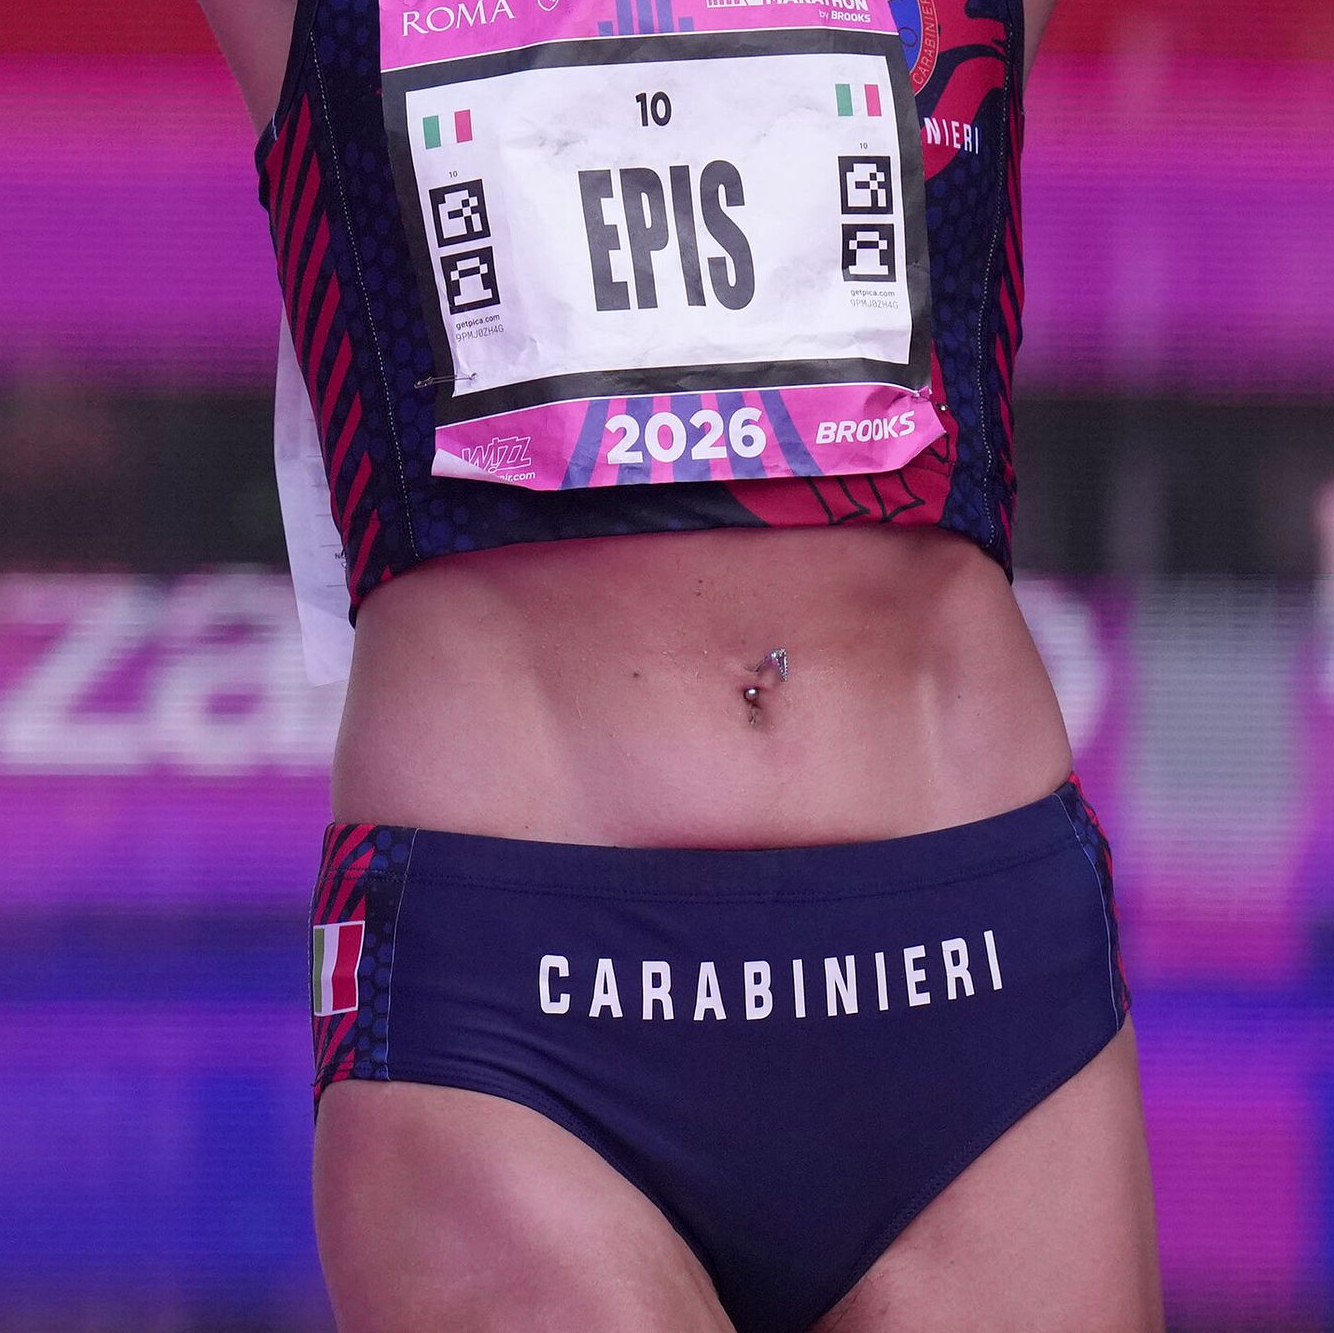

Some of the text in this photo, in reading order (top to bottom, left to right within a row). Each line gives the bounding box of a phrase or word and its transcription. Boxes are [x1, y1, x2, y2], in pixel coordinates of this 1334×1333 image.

[818, 9, 871, 23] by BROOKS
[635, 91, 672, 127] 10
[859, 142, 868, 150] 10
[449, 170, 458, 179] 10
[577, 159, 756, 312] EPIS
[850, 288, 896, 299] getpica.com
[455, 313, 501, 331] getpica.com
[604, 407, 767, 464] 2026
[815, 411, 916, 445] BROOKS
[538, 930, 1003, 1021] CARABINIERI
